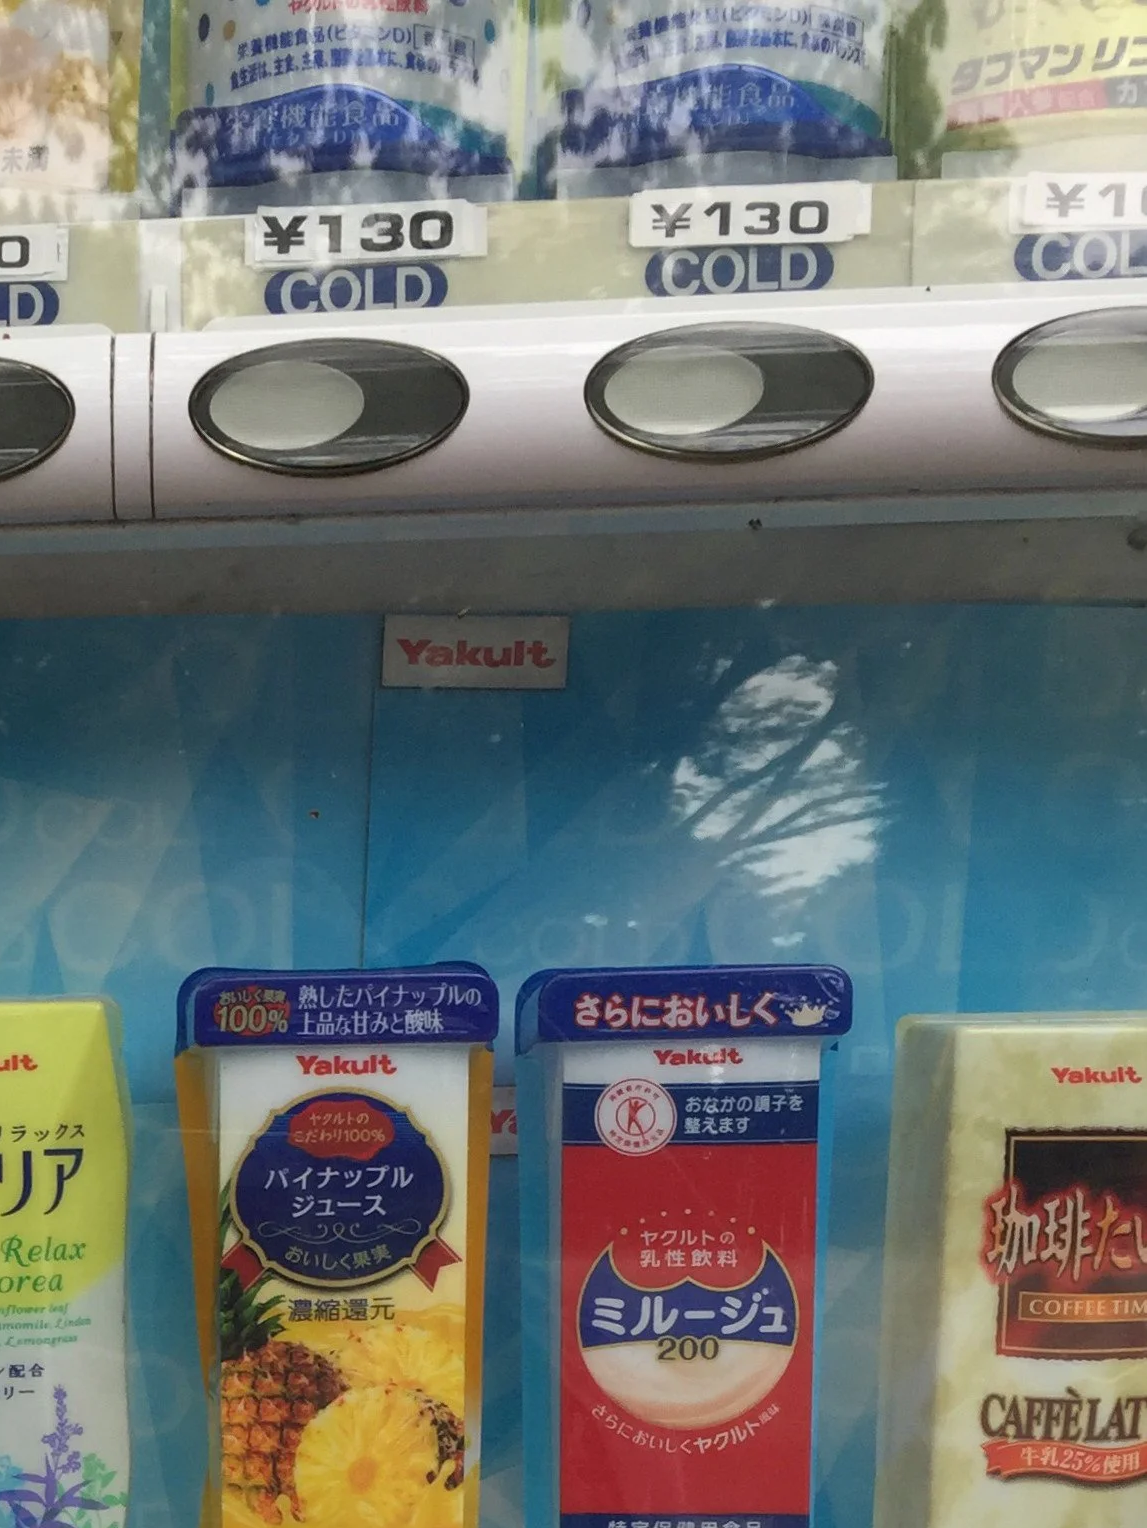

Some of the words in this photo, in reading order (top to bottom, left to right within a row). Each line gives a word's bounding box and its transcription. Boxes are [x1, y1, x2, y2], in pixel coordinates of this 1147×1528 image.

[651, 200, 829, 238] ¥130
[262, 210, 454, 254] ¥130
[661, 248, 819, 296] COLD
[280, 265, 433, 313] COLD
[396, 638, 557, 668] Yakult
[218, 1006, 289, 1034] 100%
[297, 1008, 444, 1037] 上品な甘みと酸味
[573, 992, 779, 1030] さらにおいしく
[295, 1054, 397, 1076] Yakult
[653, 1047, 744, 1067] Yakult
[1051, 1067, 1143, 1085] Yakult
[684, 1092, 804, 1114] おなかの調子を
[309, 1112, 370, 1126] ヤクルトの
[683, 1116, 751, 1137] 整えます
[292, 1128, 386, 1144] こだわり100%
[263, 1166, 414, 1191] パイナップル
[291, 1194, 387, 1218] ジュース
[639, 1229, 736, 1246] ヤクルトの
[1, 1234, 87, 1268] Relax
[284, 1244, 392, 1271] おいしく果実
[640, 1248, 737, 1269] 乳性飲料
[287, 1297, 395, 1322] 濃縮還元
[592, 1288, 789, 1336] ミルージュ
[1029, 1299, 1105, 1316] COFFEE
[657, 1337, 720, 1361] 200
[980, 1386, 1083, 1440] CAFFÈ
[1020, 1446, 1141, 1476] 牛乳25%使用
